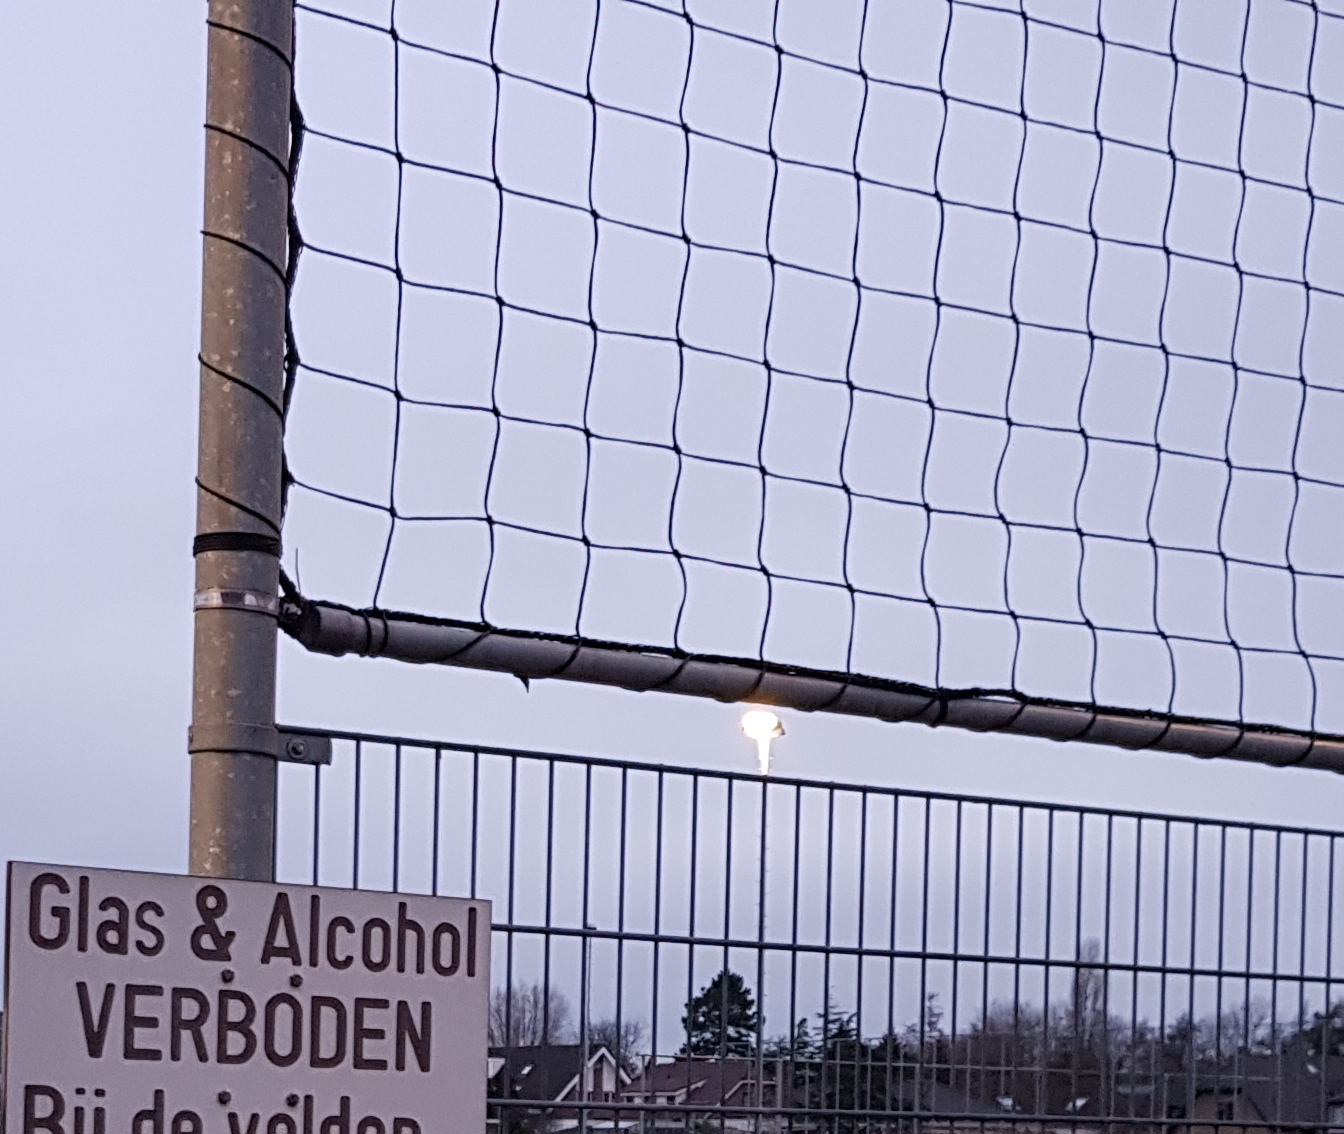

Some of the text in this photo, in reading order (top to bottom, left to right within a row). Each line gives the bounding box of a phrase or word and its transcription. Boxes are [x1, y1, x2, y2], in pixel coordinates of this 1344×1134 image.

[28, 872, 477, 977] Glas & Alcohol
[75, 981, 433, 1073] VERBODEN
